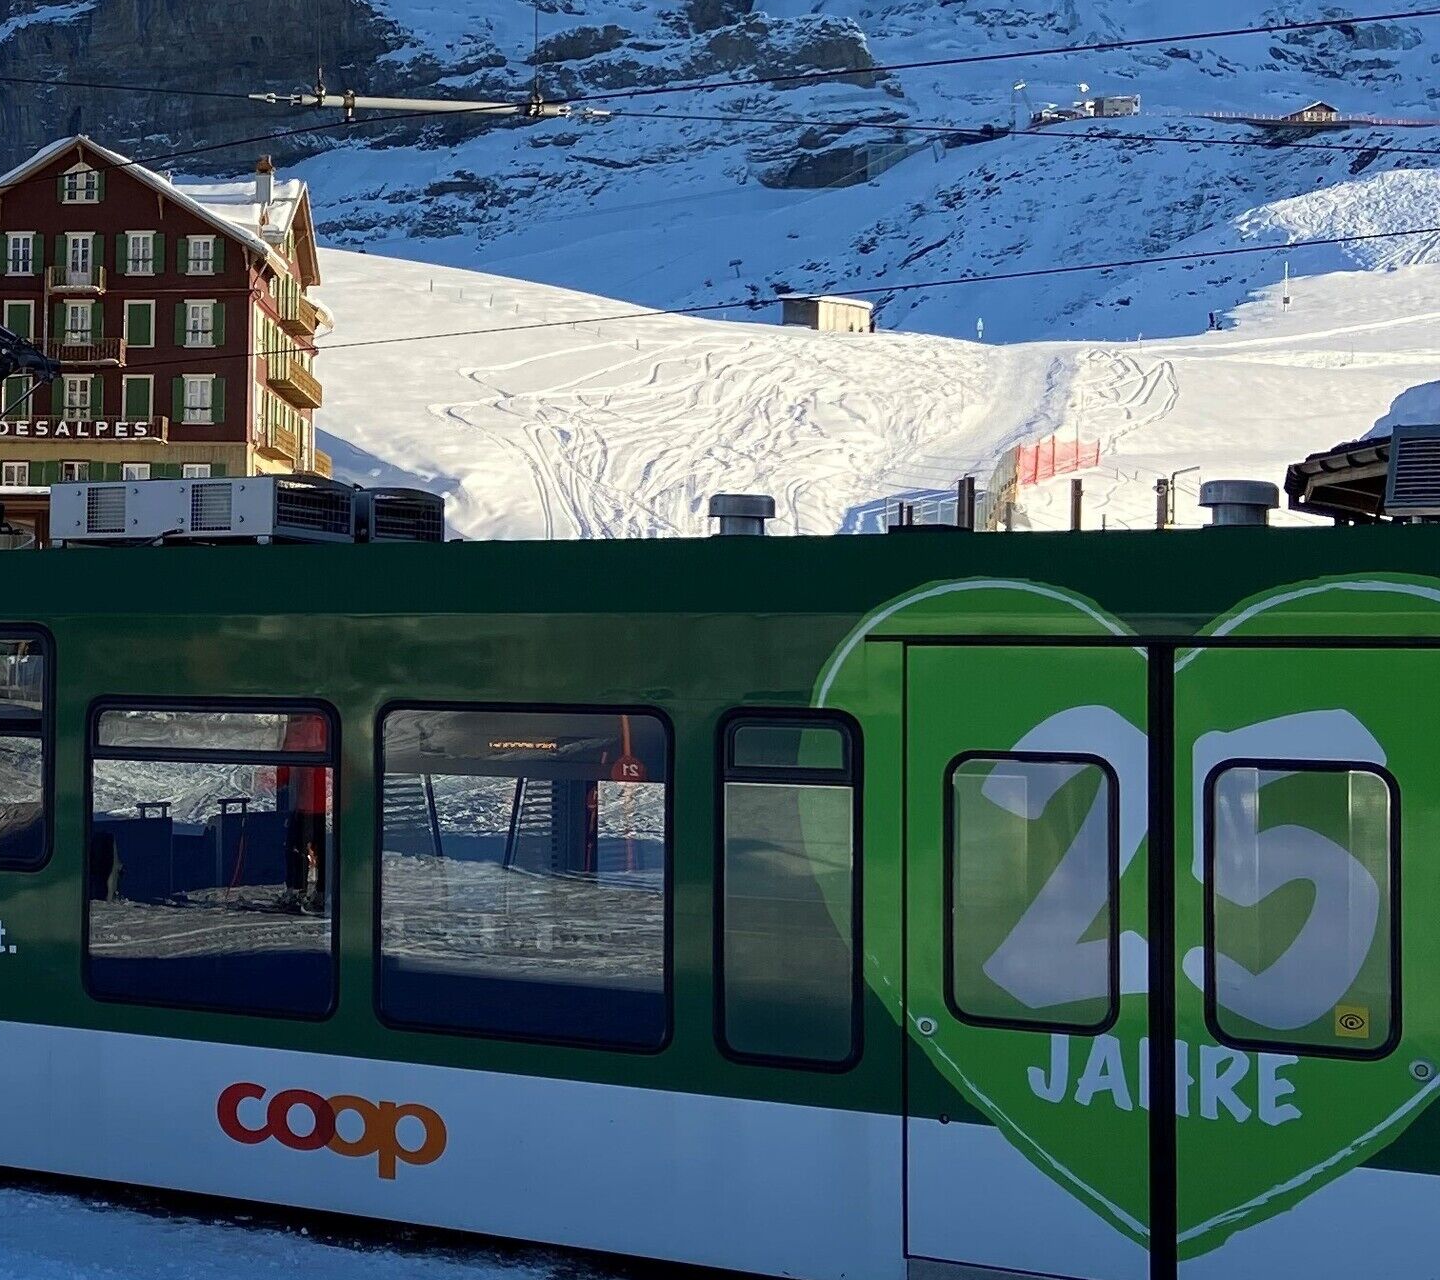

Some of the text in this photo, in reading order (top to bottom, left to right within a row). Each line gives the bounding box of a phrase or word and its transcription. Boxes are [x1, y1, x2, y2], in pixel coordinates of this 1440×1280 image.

[981, 704, 1388, 1031] 25
[1027, 1030, 1304, 1127] JAHRE
[216, 1081, 448, 1180] coop
